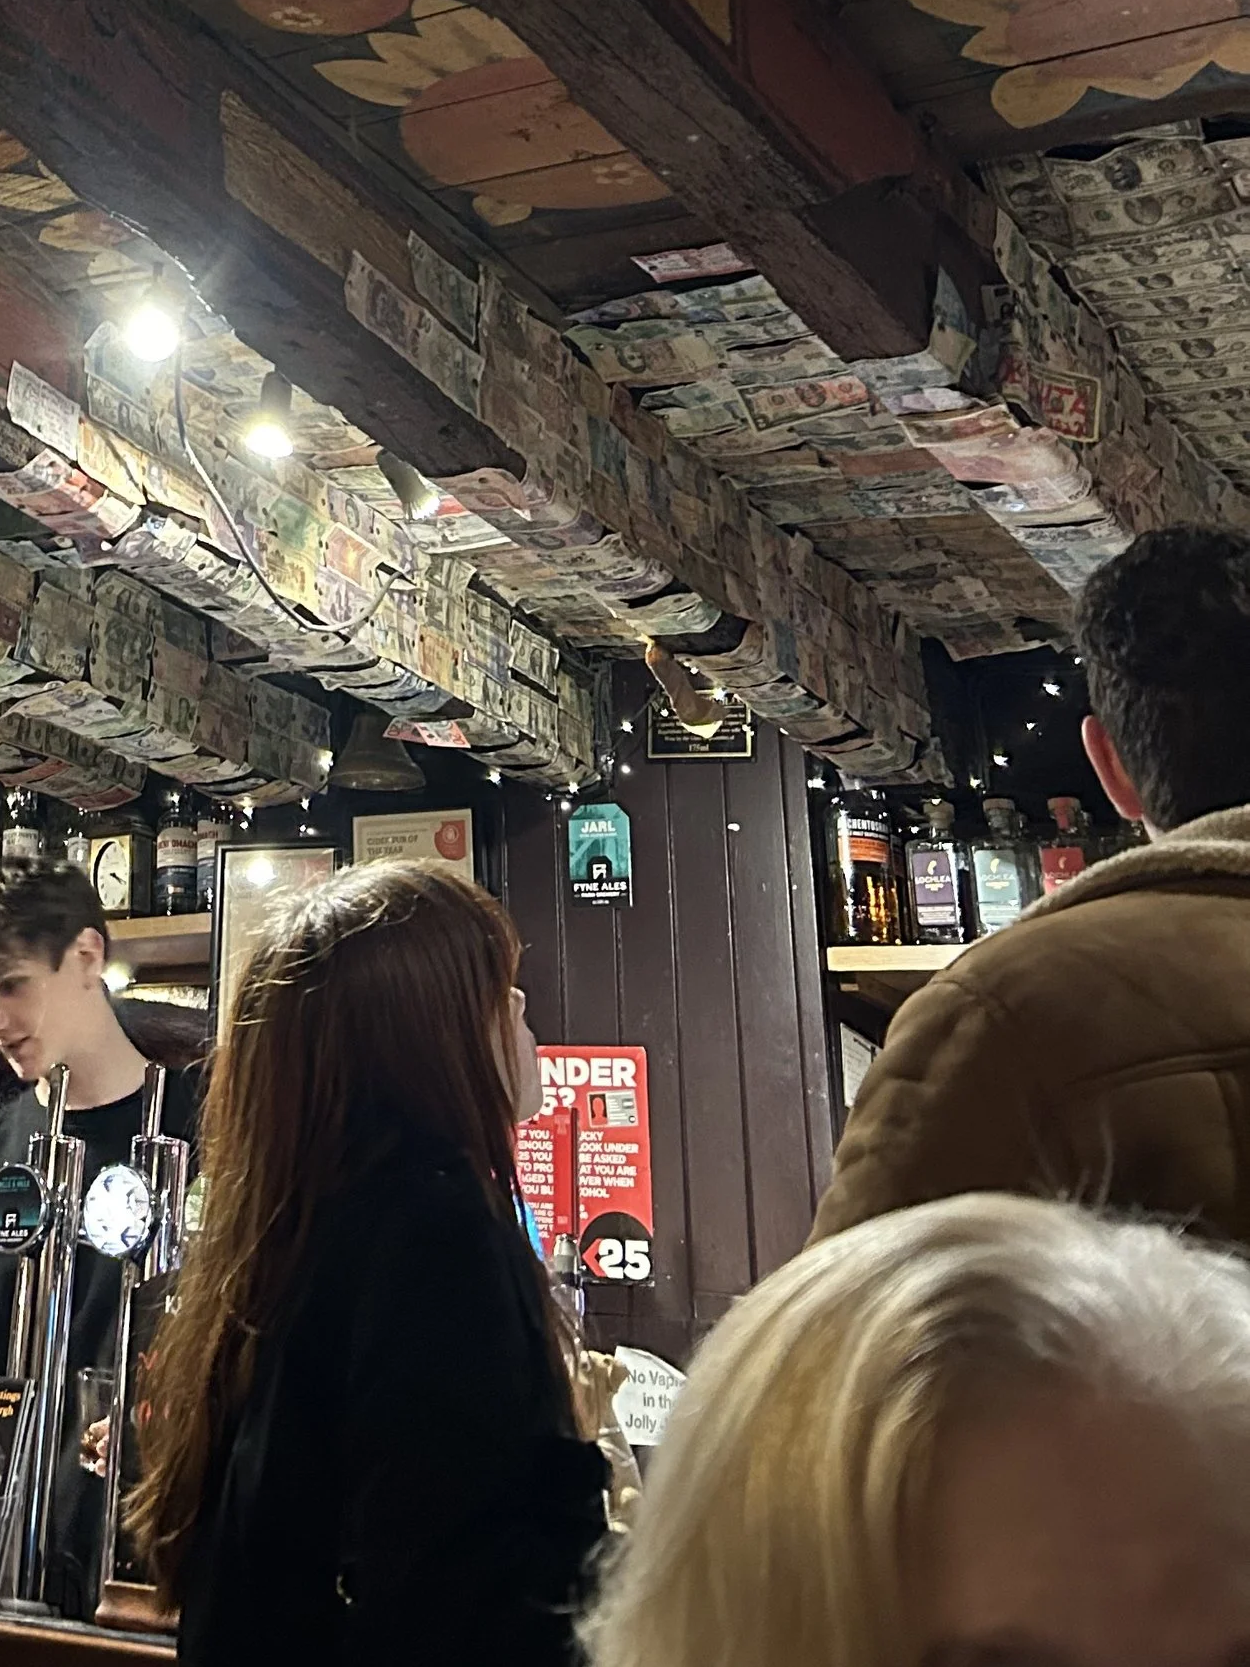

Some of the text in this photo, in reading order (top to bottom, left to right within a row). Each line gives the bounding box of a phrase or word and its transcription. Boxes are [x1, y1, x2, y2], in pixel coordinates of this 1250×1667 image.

[581, 821, 616, 833] JARL
[915, 875, 951, 884] LOCHLEA
[573, 882, 627, 892] FYNE ALES
[538, 1057, 637, 1087] NDER
[540, 1086, 576, 1116] 5?
[528, 1130, 549, 1139] YOU
[518, 1140, 553, 1150] ENOUG
[604, 1143, 638, 1153] UNDER
[531, 1152, 552, 1161] YOU
[593, 1154, 626, 1164] ASKED
[533, 1163, 553, 1173] PRO
[579, 1165, 592, 1174] AT
[595, 1165, 615, 1174] YOU
[616, 1166, 637, 1176] ARE
[602, 1177, 634, 1187] WHEN
[11, 1229, 28, 1237] ALES
[599, 1239, 650, 1280] 25
[649, 1371, 677, 1390] Vap
[643, 1393, 672, 1409] in th
[625, 1414, 657, 1433] Jolly
